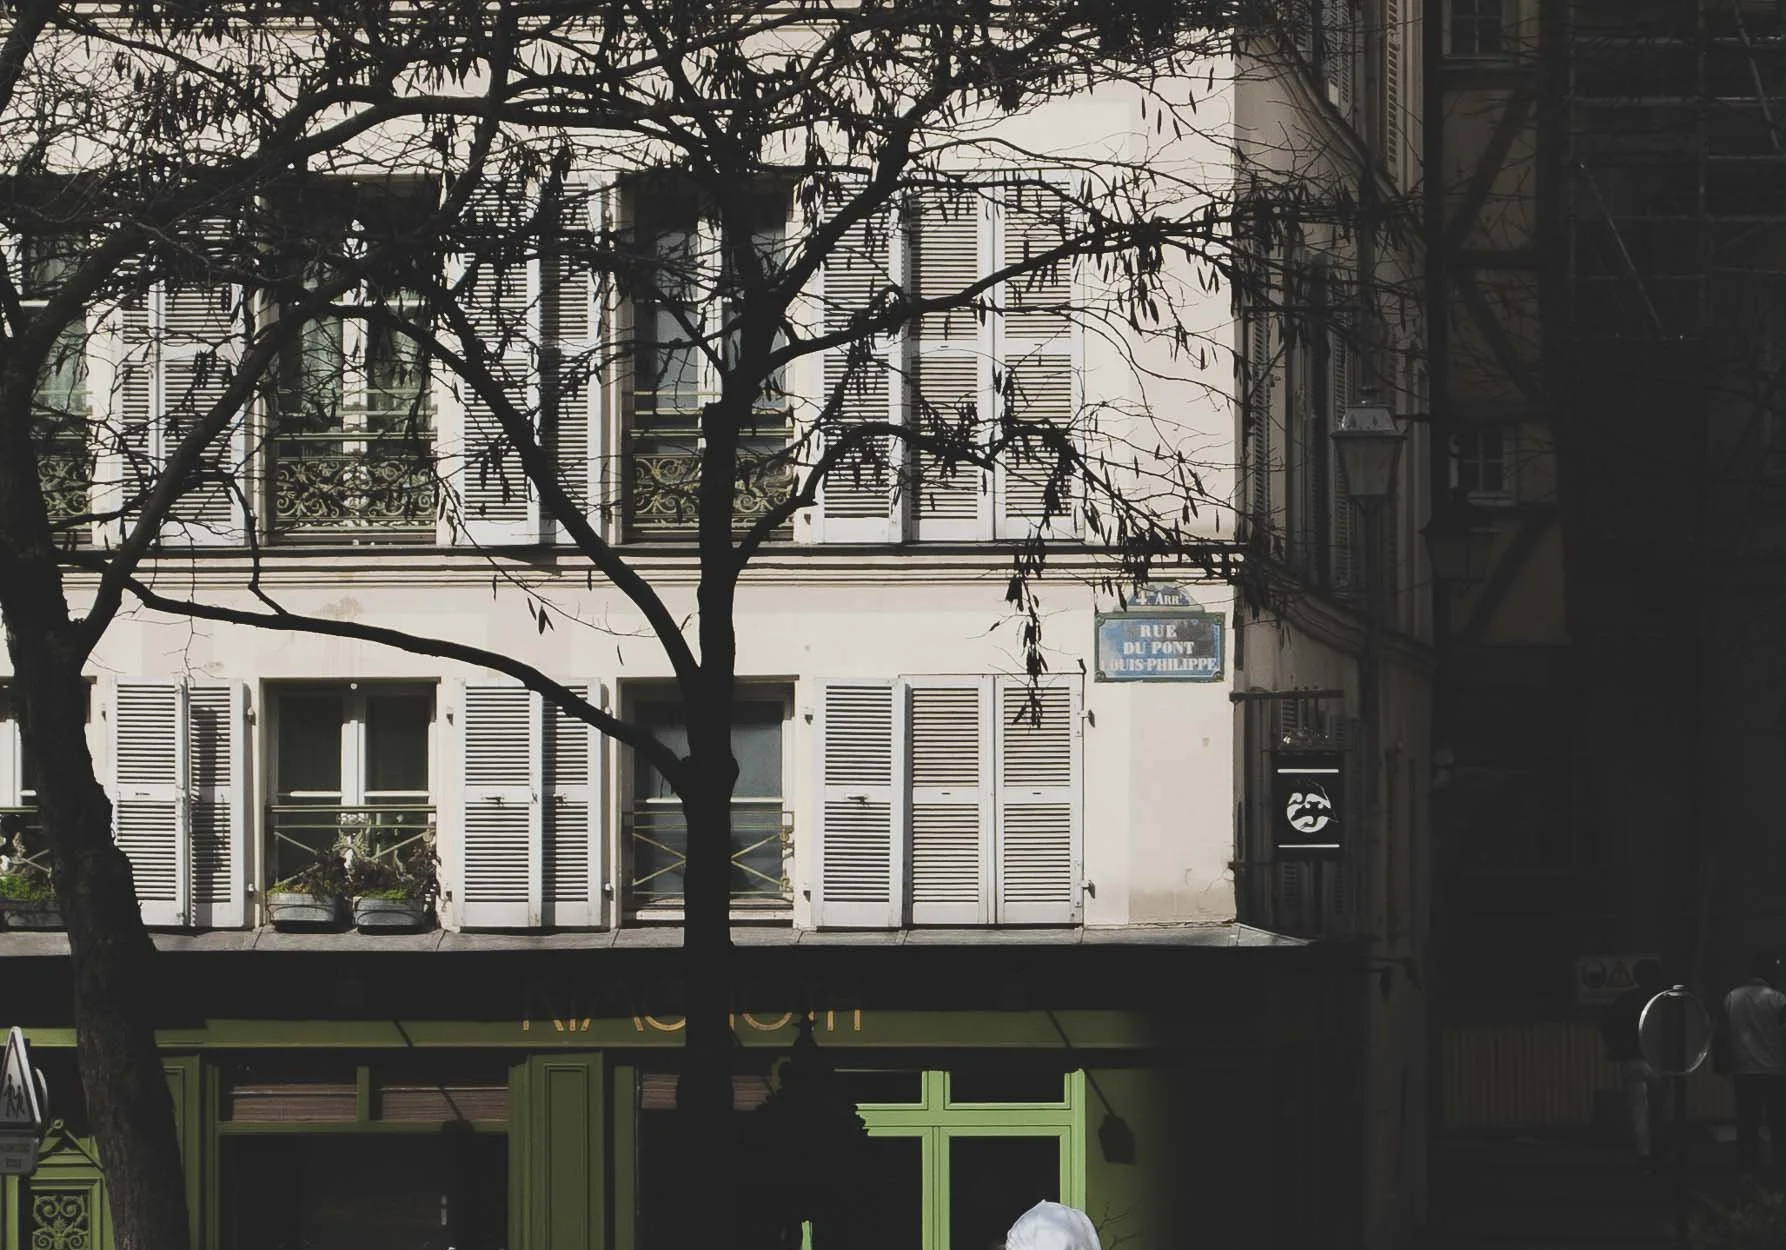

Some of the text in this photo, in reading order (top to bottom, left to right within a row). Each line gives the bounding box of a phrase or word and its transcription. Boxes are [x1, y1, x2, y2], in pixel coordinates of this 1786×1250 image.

[1140, 624, 1177, 638] RUE
[1123, 641, 1194, 655] DU PONT
